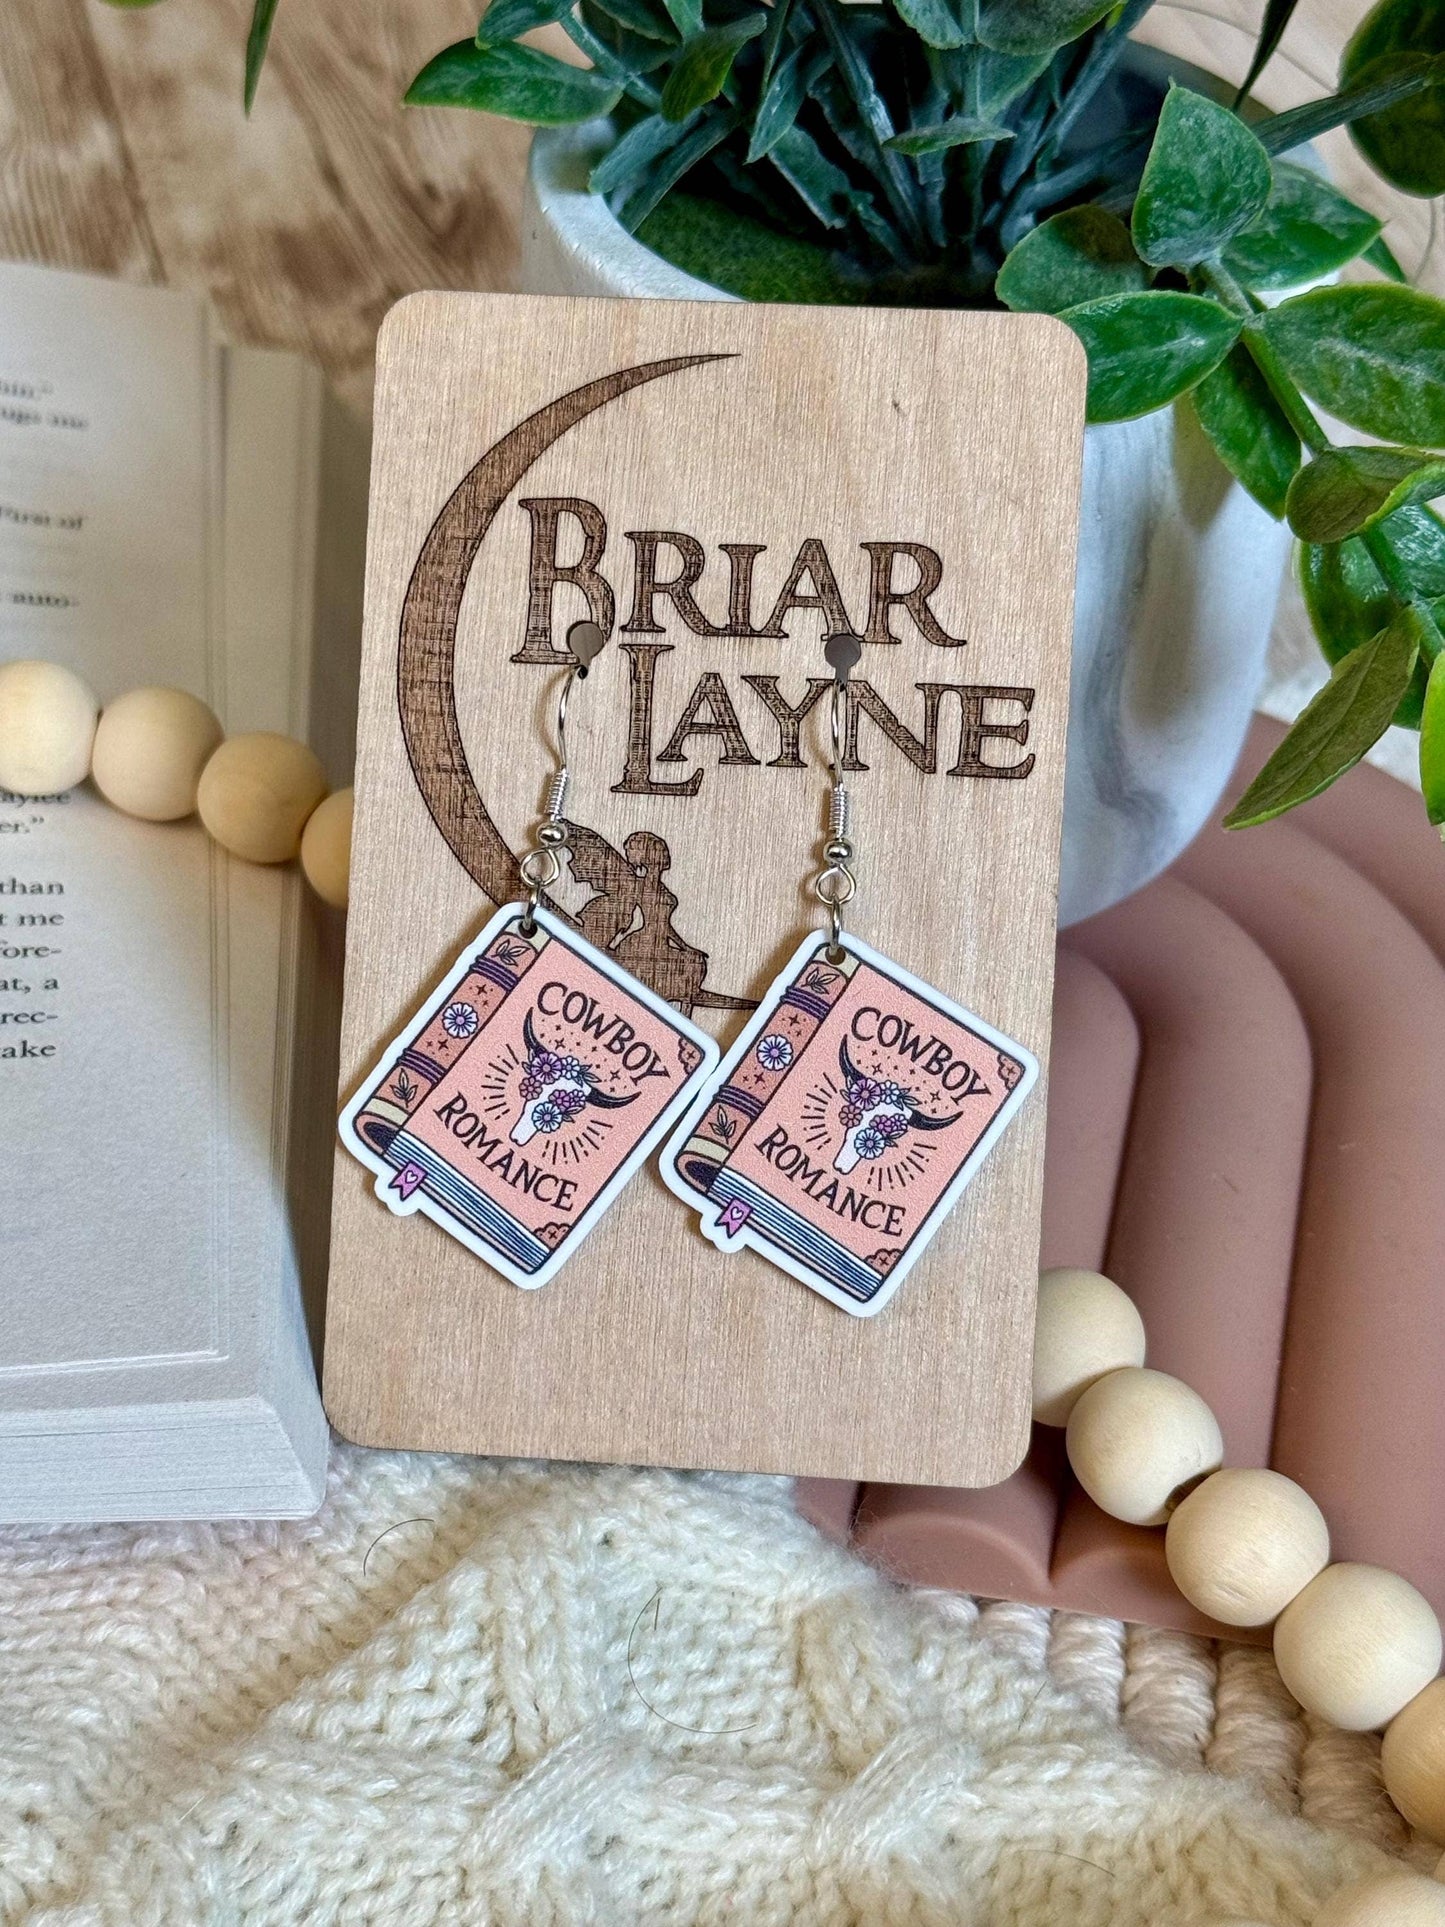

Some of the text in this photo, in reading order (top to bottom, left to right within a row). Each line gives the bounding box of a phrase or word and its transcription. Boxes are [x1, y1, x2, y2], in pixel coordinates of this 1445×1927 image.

[510, 498, 967, 665] BRIAR
[610, 643, 1036, 796] LAYNE
[18, 914, 65, 927] me
[44, 979, 60, 990] a
[537, 981, 671, 1086] COWBOY
[850, 1006, 992, 1107] COWBOY
[433, 1091, 579, 1212] ROMANCE
[754, 1124, 906, 1237] ROMANCE
